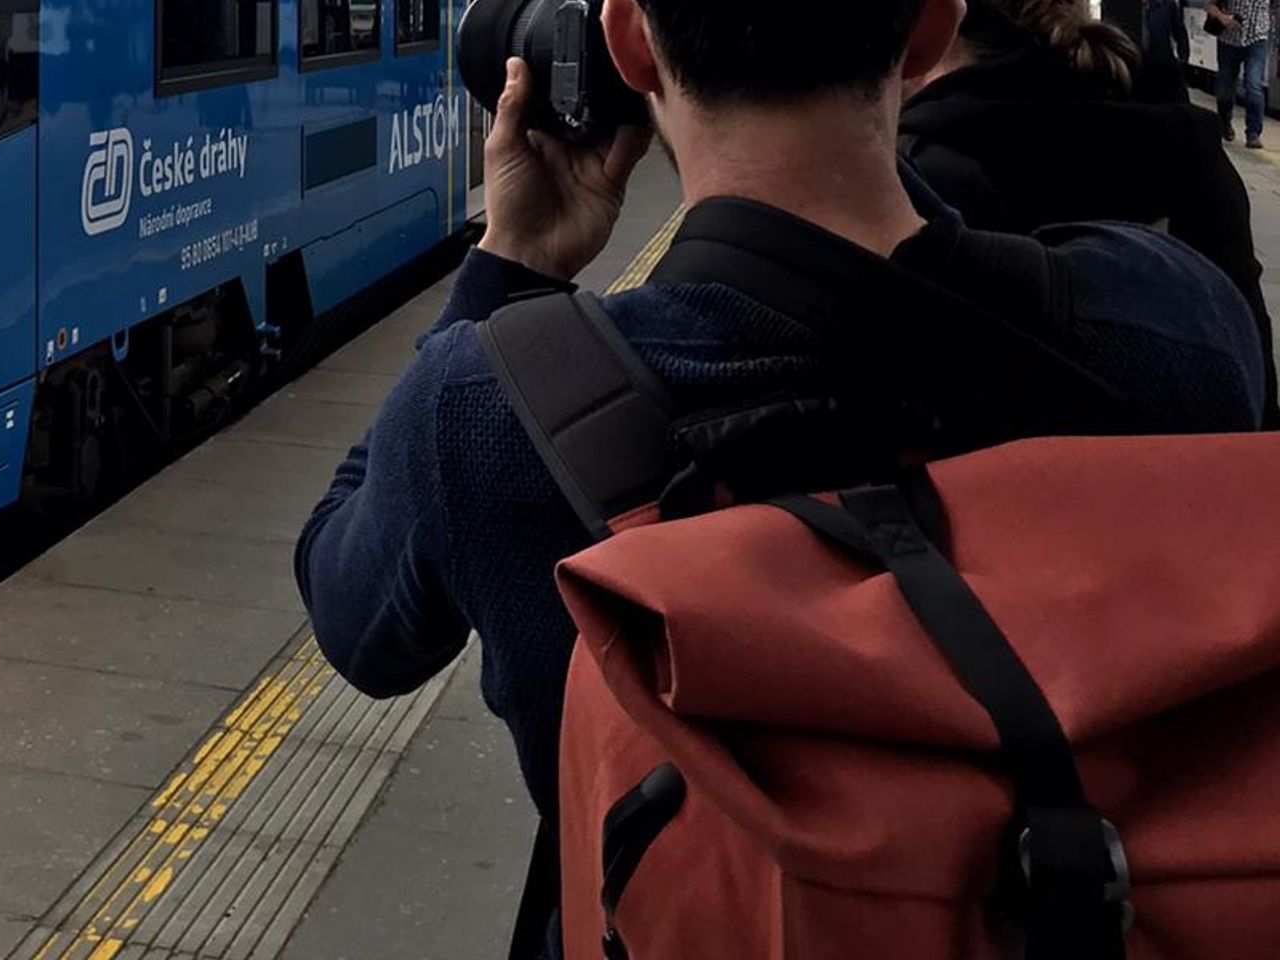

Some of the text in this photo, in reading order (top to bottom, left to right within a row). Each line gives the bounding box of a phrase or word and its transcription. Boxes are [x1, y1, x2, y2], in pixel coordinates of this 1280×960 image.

[139, 127, 249, 198] České dráhy
[388, 93, 460, 175] ALSTOM
[139, 196, 213, 239] Národní dopravce
